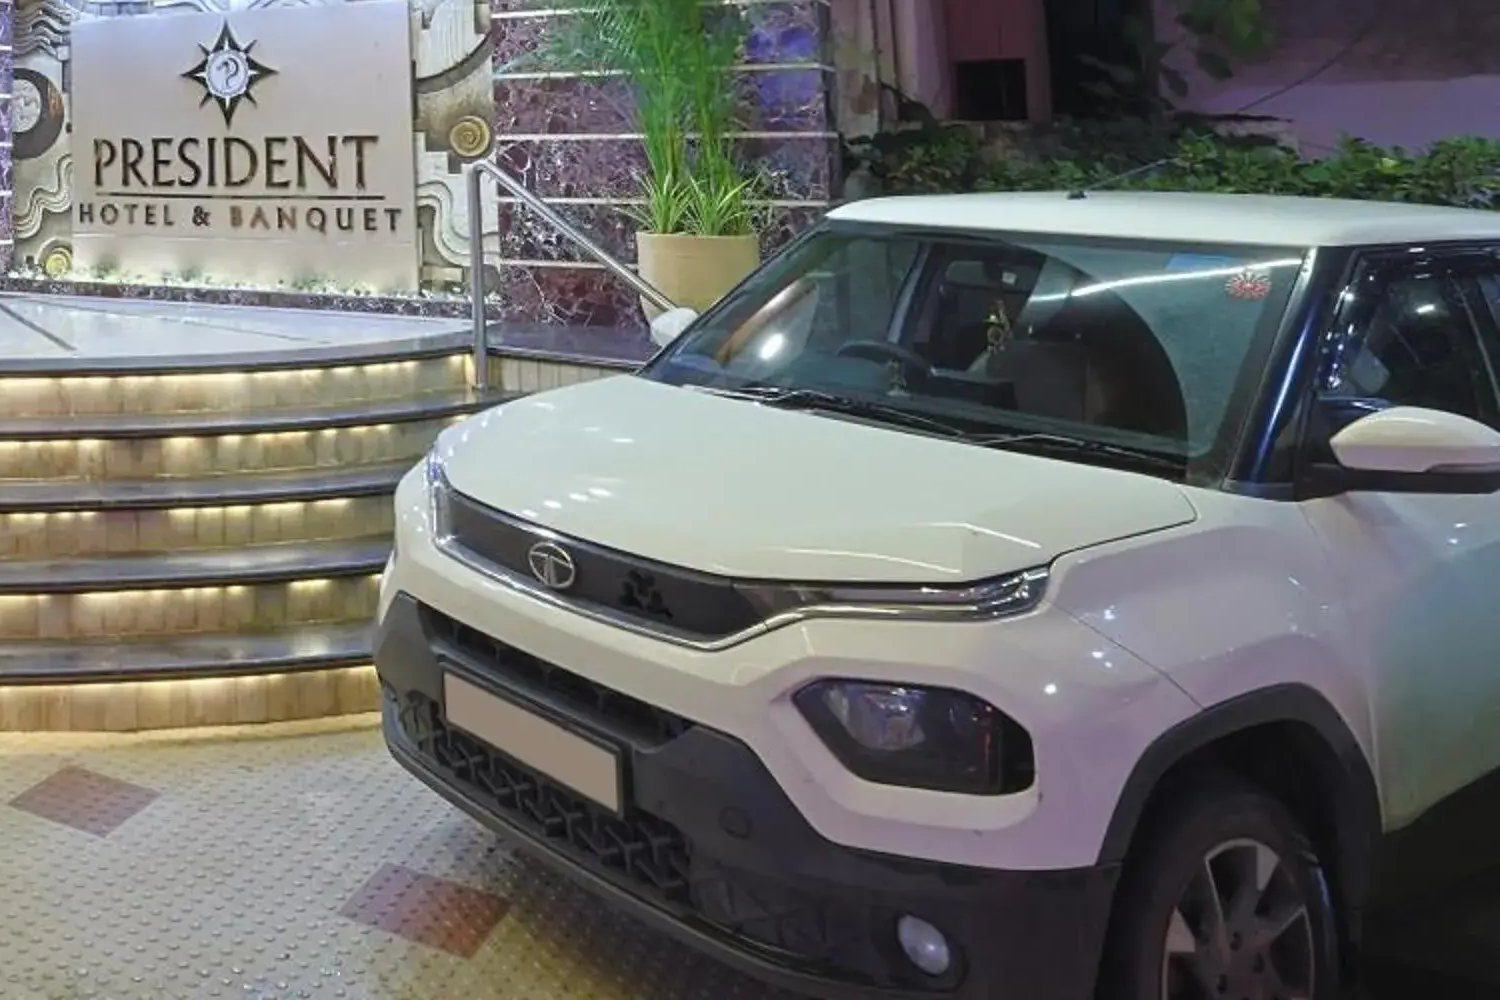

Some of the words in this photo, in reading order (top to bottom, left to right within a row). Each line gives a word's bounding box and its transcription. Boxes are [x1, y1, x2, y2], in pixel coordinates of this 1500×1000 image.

[93, 135, 379, 188] PRESIDENT
[79, 203, 174, 226] HOTEL
[192, 205, 211, 227] &
[230, 205, 402, 233] BANQUET
